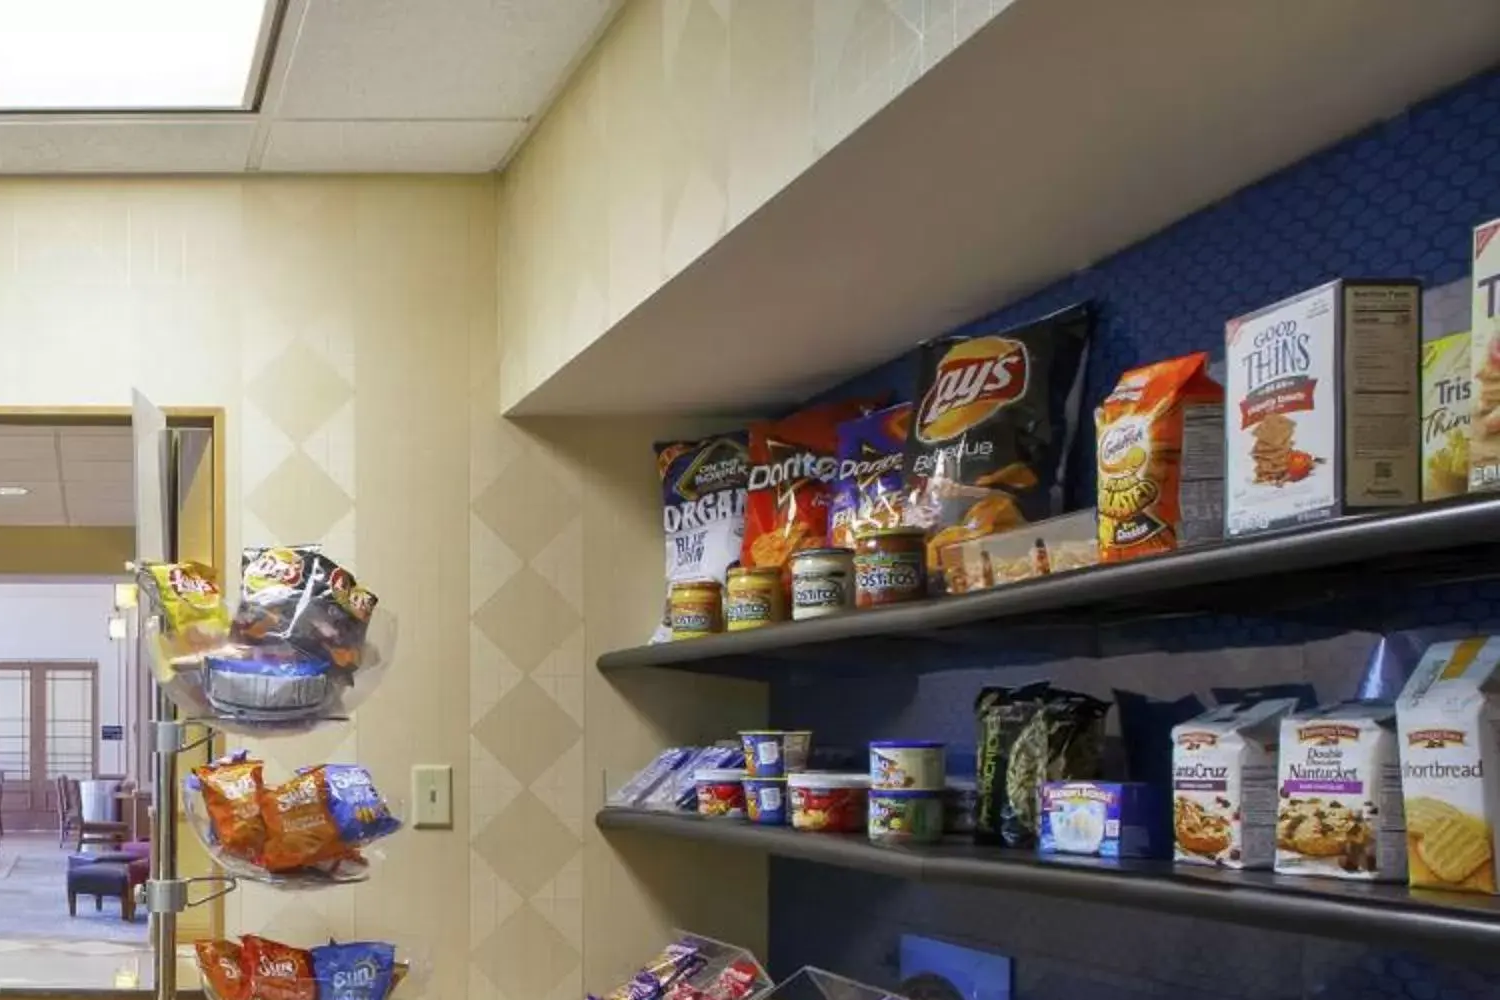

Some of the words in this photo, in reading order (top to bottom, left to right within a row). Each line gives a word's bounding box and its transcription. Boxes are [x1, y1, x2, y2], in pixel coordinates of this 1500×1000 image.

[1254, 319, 1297, 348] GOOD
[1436, 379, 1471, 405] Tris
[751, 453, 838, 491] Doritos
